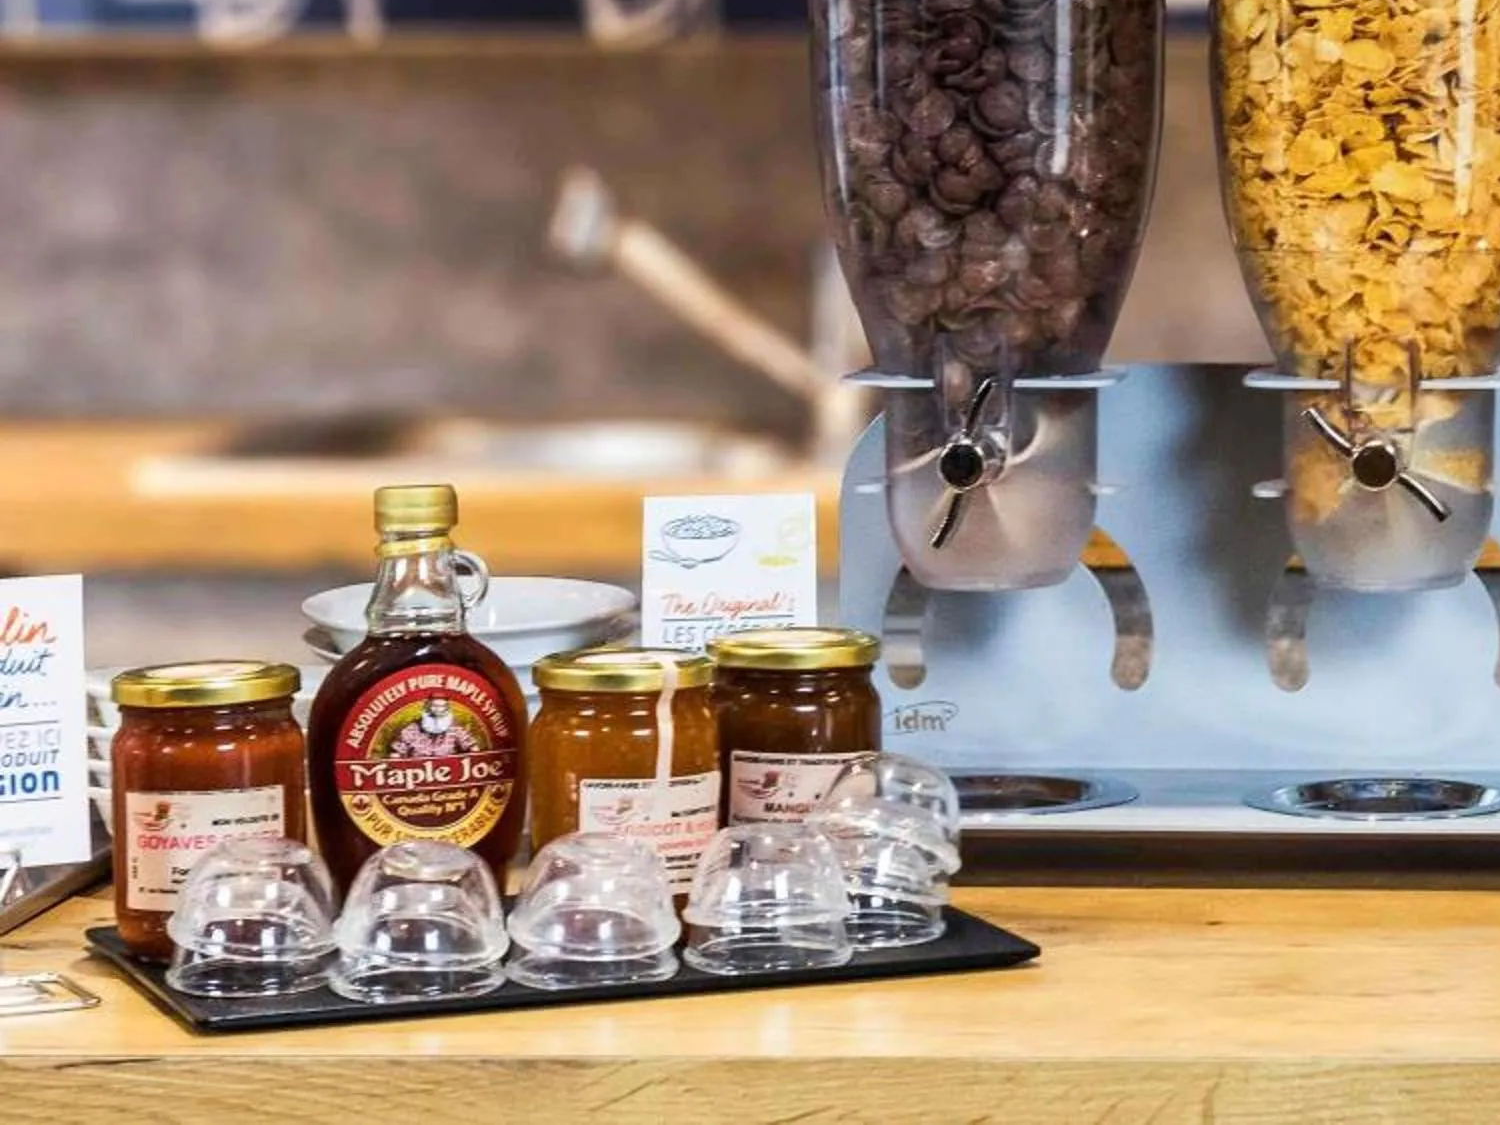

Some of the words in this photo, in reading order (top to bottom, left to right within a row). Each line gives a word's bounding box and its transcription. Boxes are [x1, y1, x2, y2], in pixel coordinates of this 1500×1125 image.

[661, 593, 697, 615] The
[661, 625, 695, 644] LES
[345, 681, 408, 749] ABSOLUTELY
[408, 674, 446, 690] PURE
[446, 675, 487, 707] MAPLE
[895, 707, 947, 732] idm
[0, 729, 30, 751] EZ
[37, 728, 62, 749] ICI
[350, 761, 451, 790] Maple
[459, 757, 504, 781] Joe
[397, 802, 442, 817] Quality
